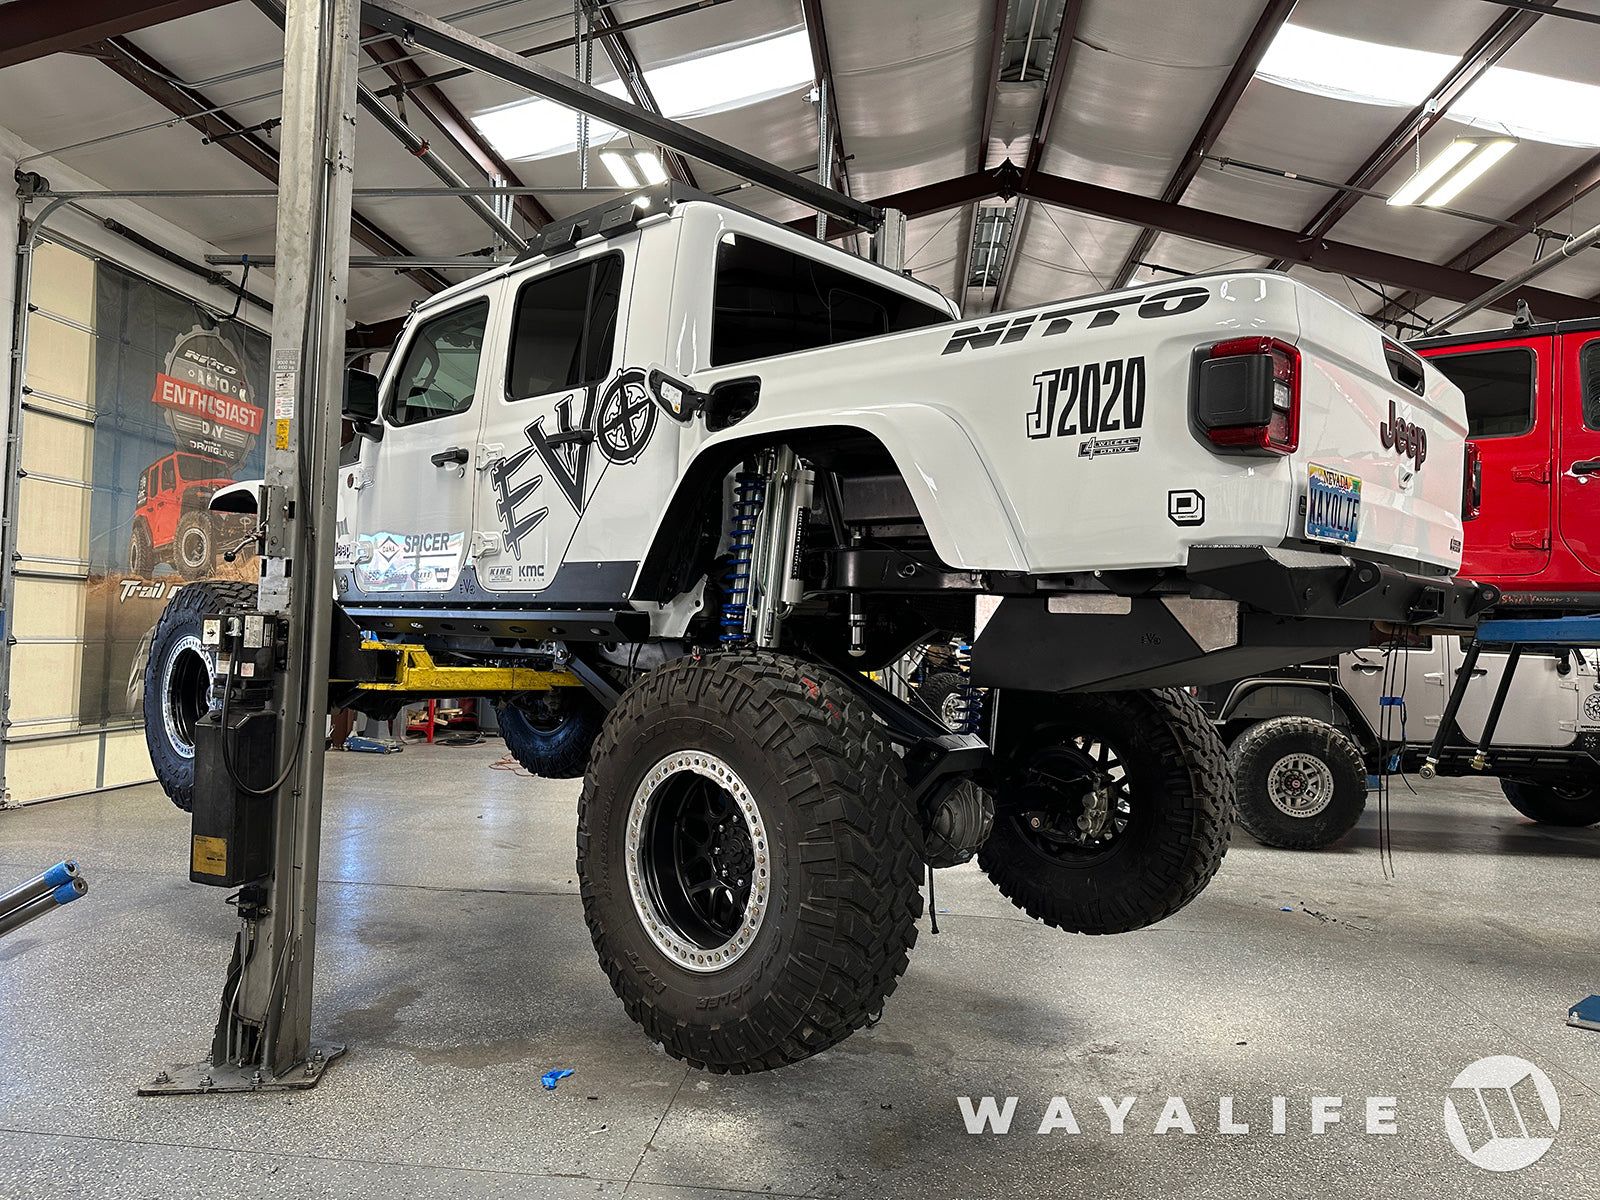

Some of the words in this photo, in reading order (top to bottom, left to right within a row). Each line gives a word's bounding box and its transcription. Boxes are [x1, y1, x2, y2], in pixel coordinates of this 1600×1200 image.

[941, 286, 1210, 355] NITTO
[185, 349, 236, 375] NITTO
[163, 380, 256, 427] ENTHUSIAST
[1380, 400, 1427, 471] Jeep
[490, 366, 659, 561] EVO
[1323, 470, 1350, 489] NEVADA
[403, 532, 450, 553] SPICER
[519, 565, 544, 577] KMC
[120, 580, 165, 602] Trail
